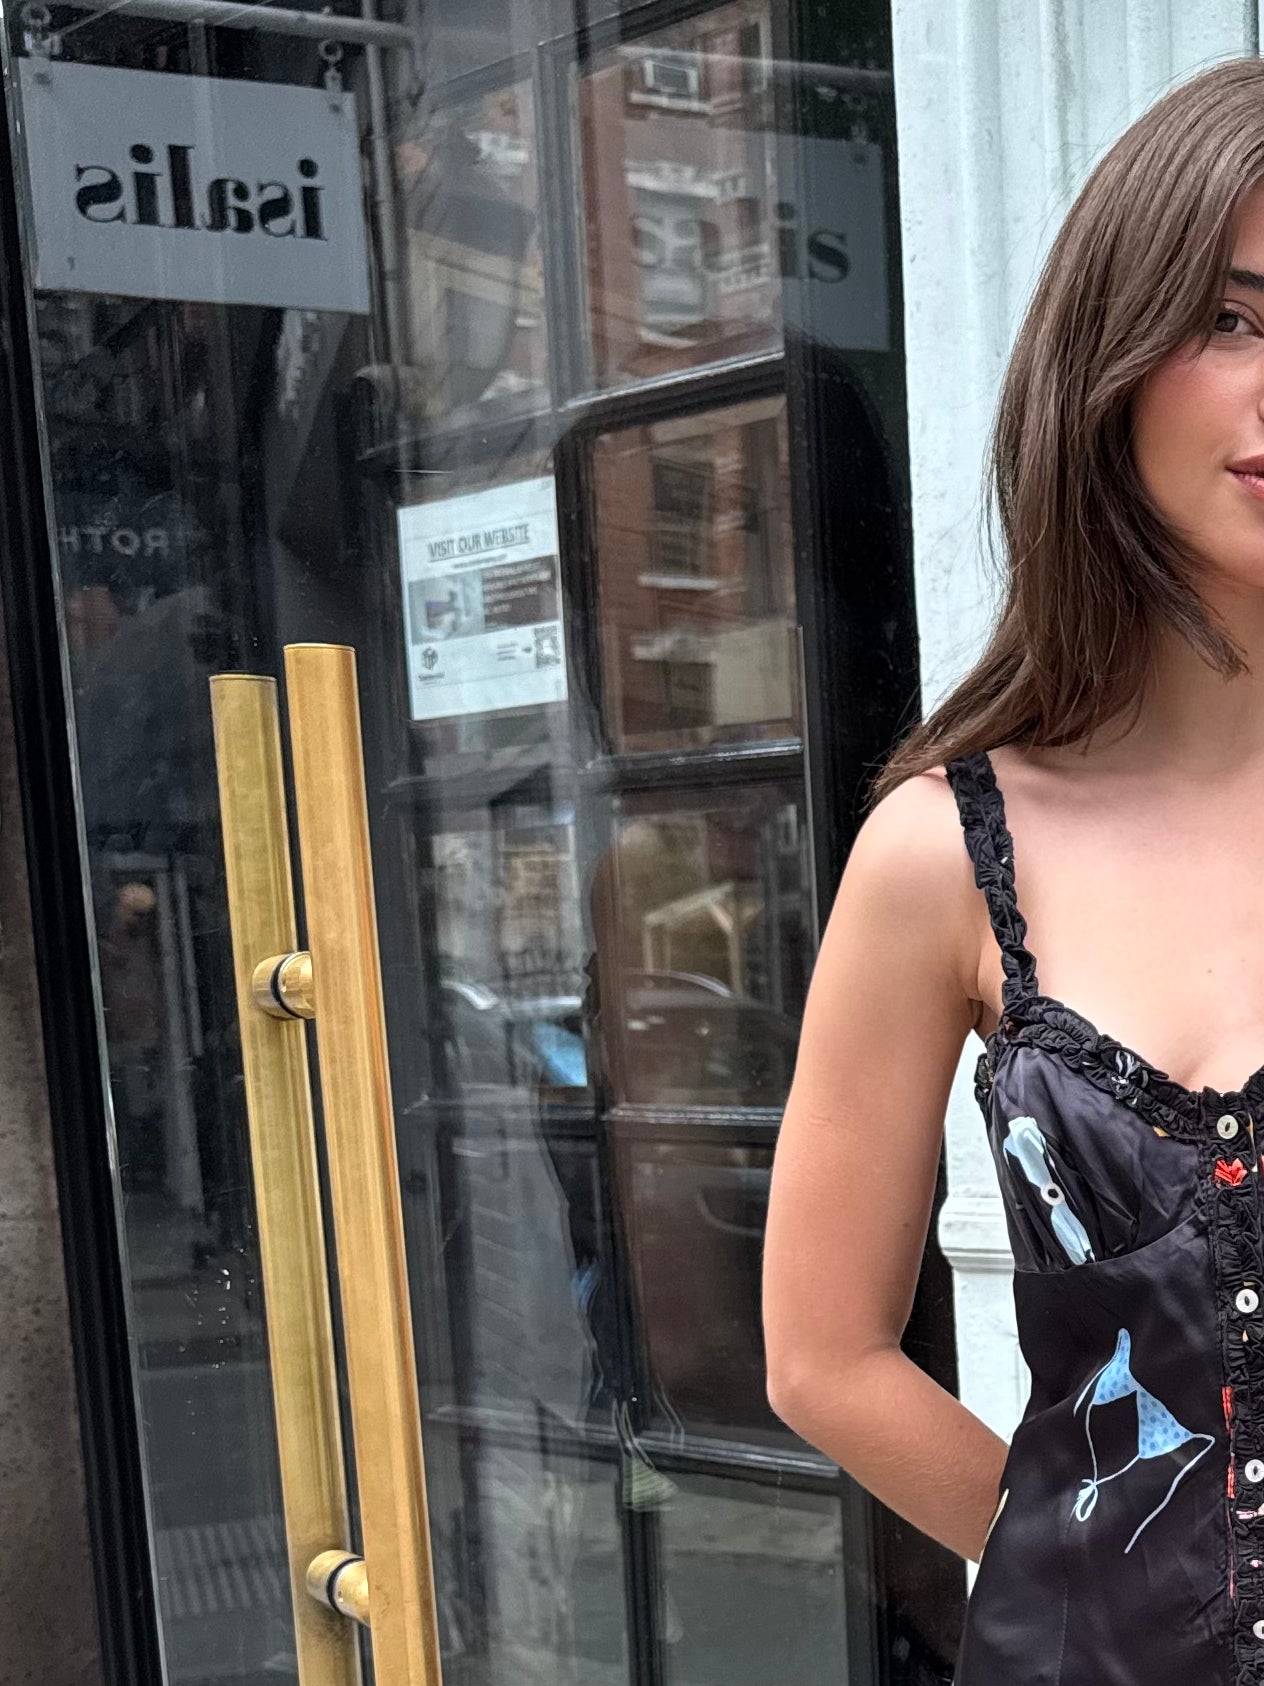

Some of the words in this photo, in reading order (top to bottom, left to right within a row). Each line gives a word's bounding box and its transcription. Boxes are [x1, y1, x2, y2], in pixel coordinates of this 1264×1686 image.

[428, 537, 456, 559] VISIT
[457, 533, 482, 553] OUR
[484, 523, 531, 547] WEBSITE
